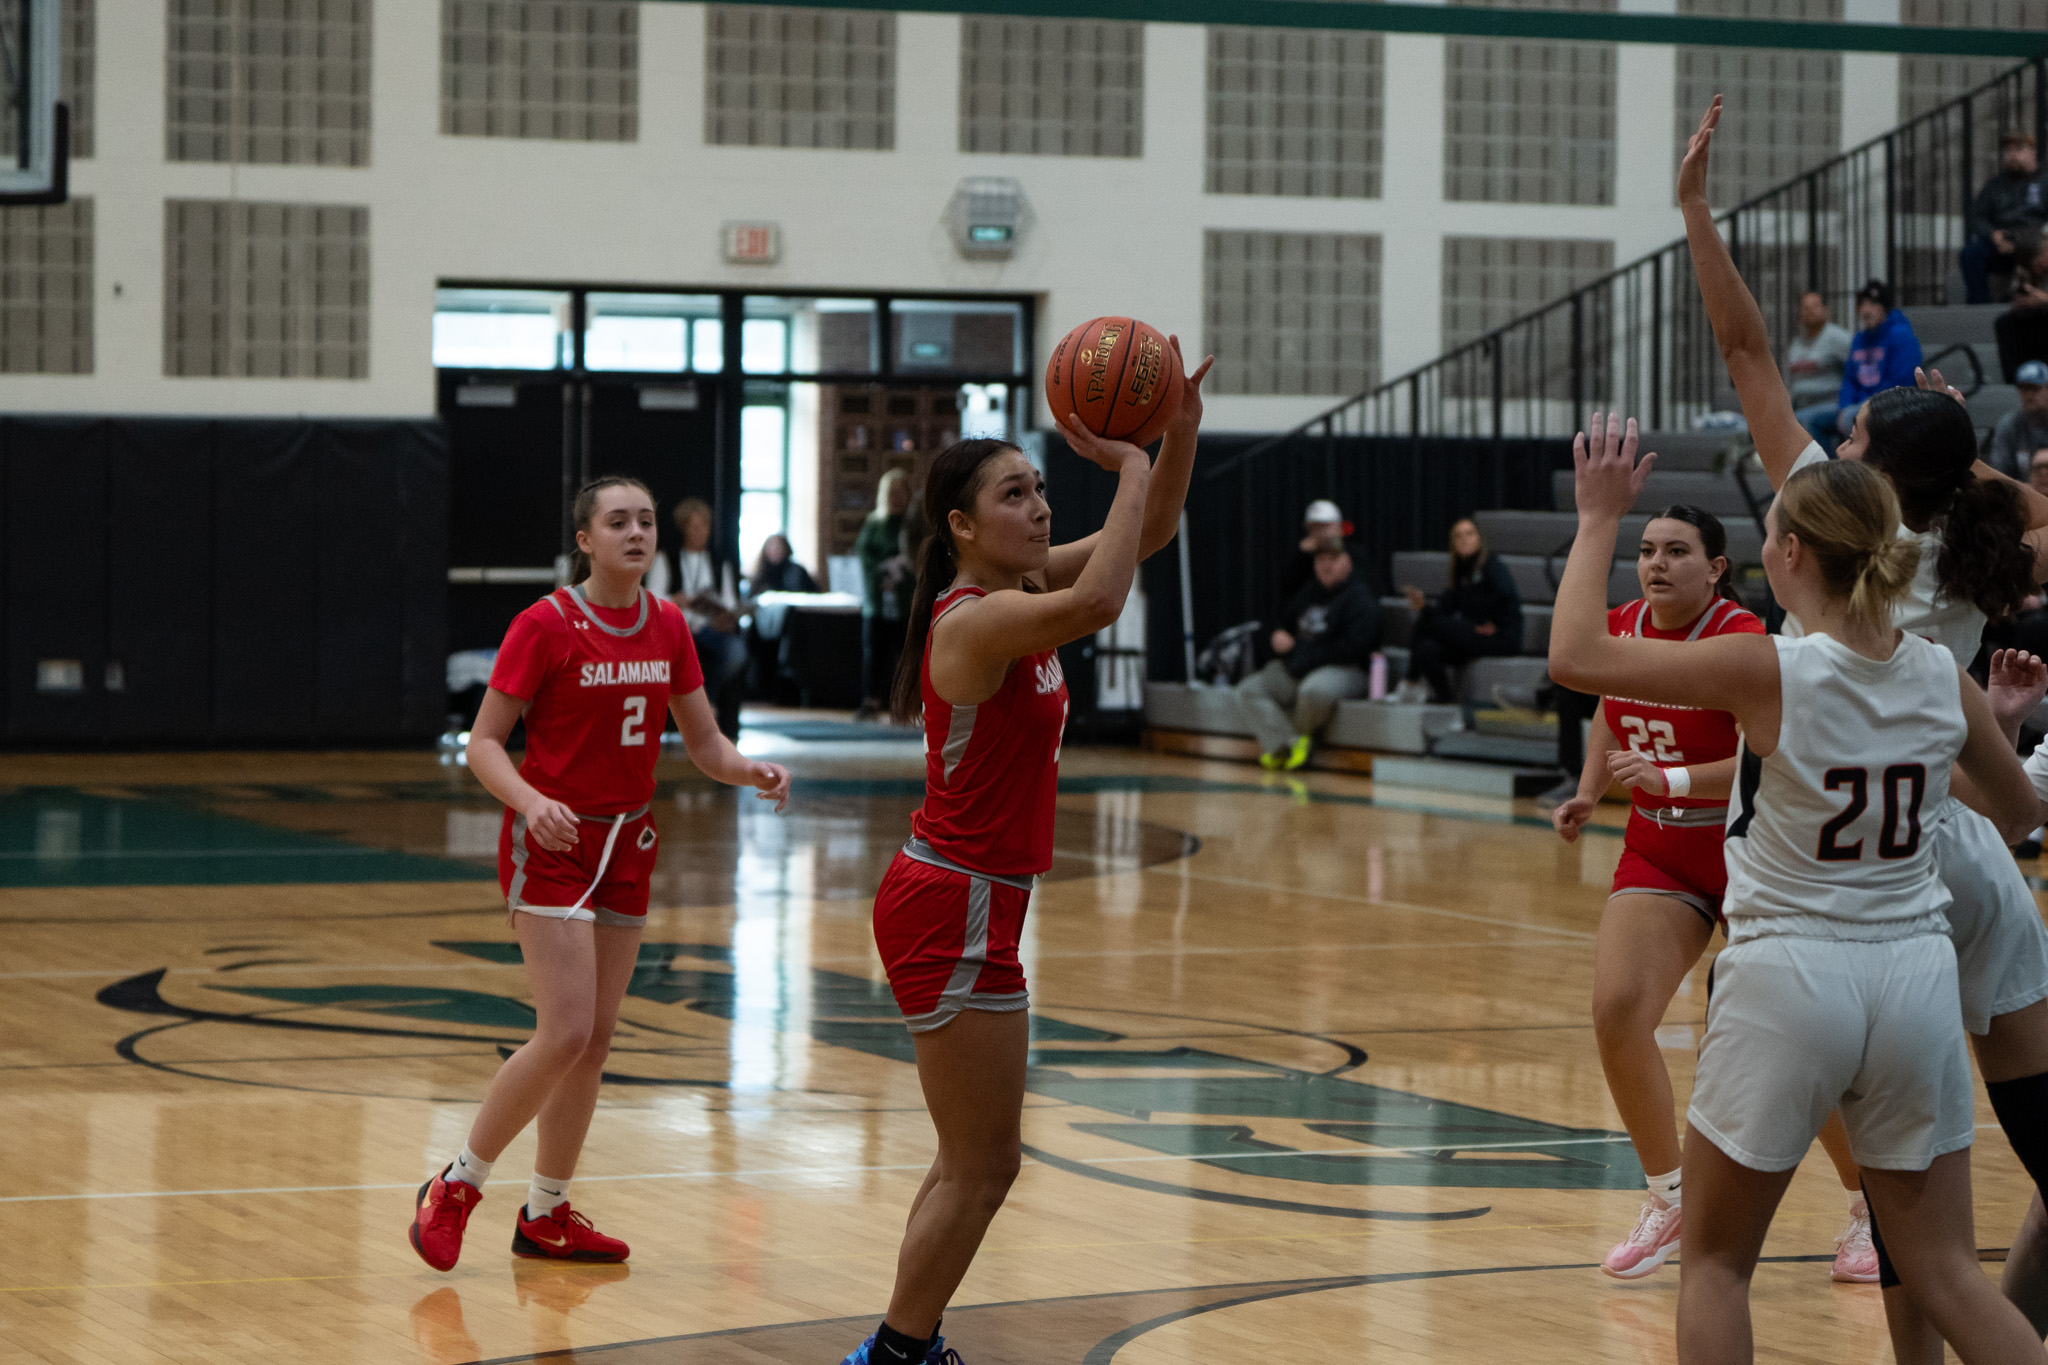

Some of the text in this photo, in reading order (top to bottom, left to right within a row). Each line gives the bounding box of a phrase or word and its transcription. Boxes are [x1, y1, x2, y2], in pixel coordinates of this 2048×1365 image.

[1085, 323, 1126, 405] SPALDING
[1125, 331, 1154, 406] LEGACY
[621, 696, 647, 746] 2
[1620, 715, 1685, 762] 22
[1815, 762, 1926, 862] 20
